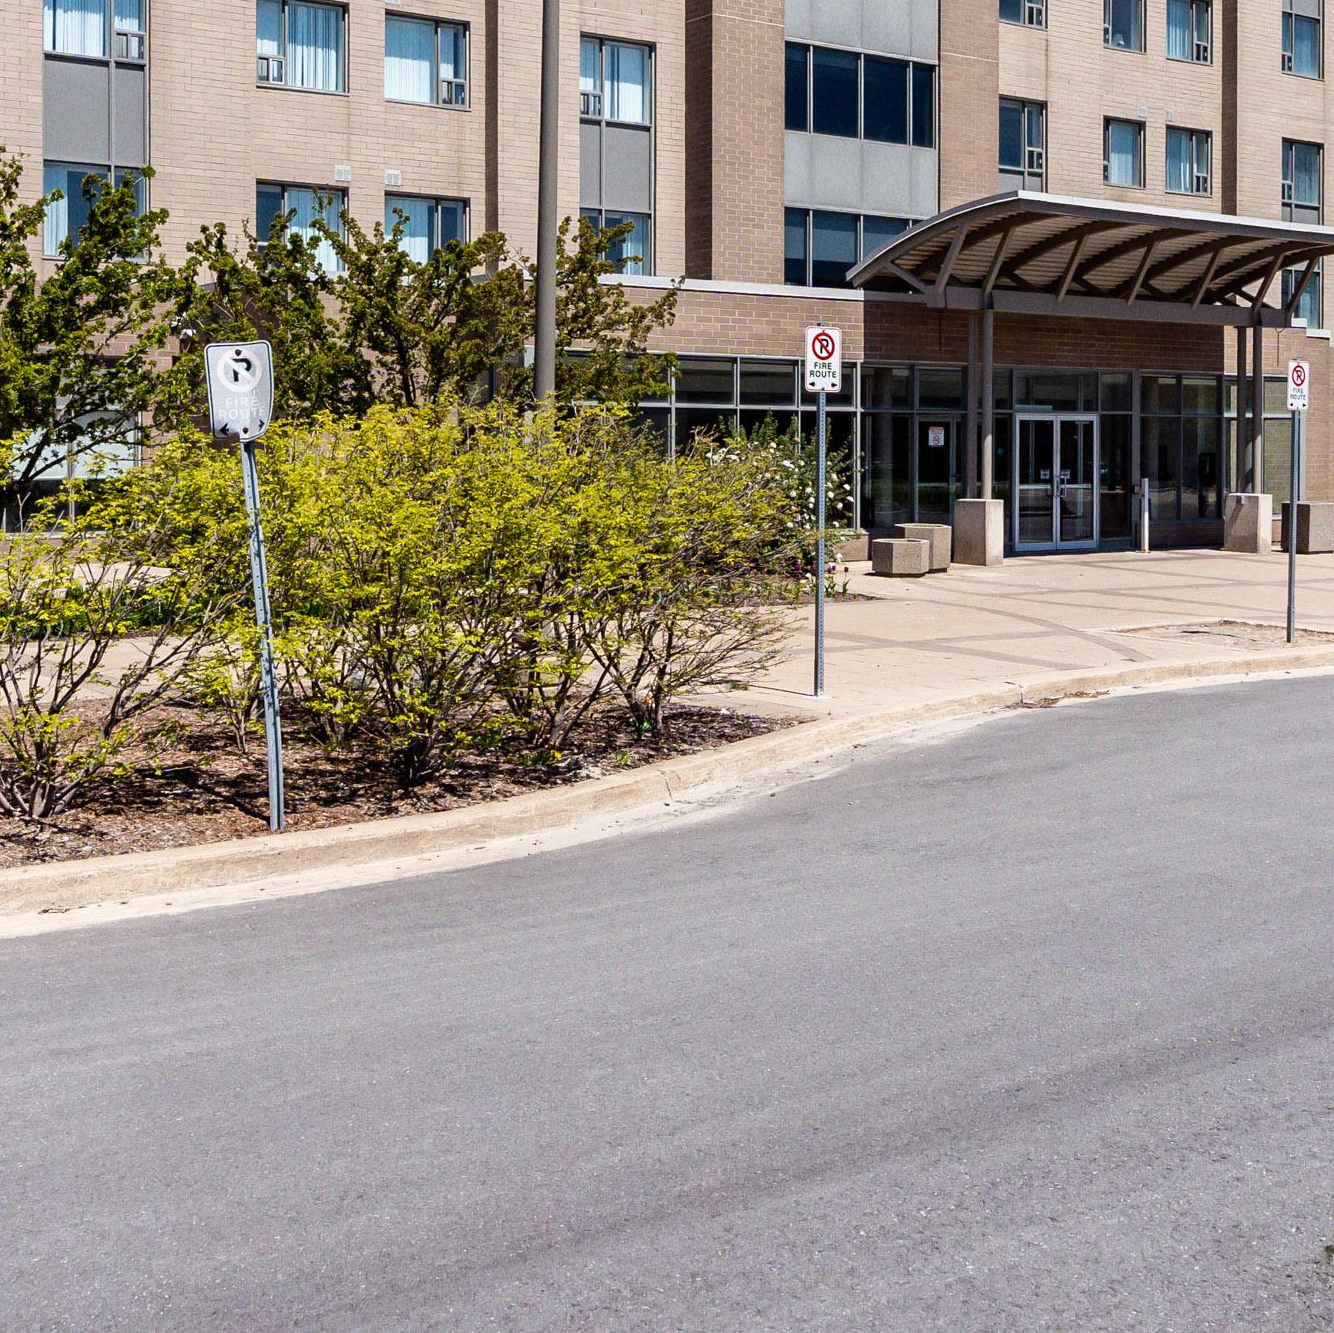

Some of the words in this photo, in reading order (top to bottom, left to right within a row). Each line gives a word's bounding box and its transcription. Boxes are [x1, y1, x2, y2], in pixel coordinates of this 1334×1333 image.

[813, 361, 833, 370] FIRE
[809, 370, 837, 379] ROUTE
[224, 396, 260, 409] FIRE
[217, 406, 266, 420] ROUTE
